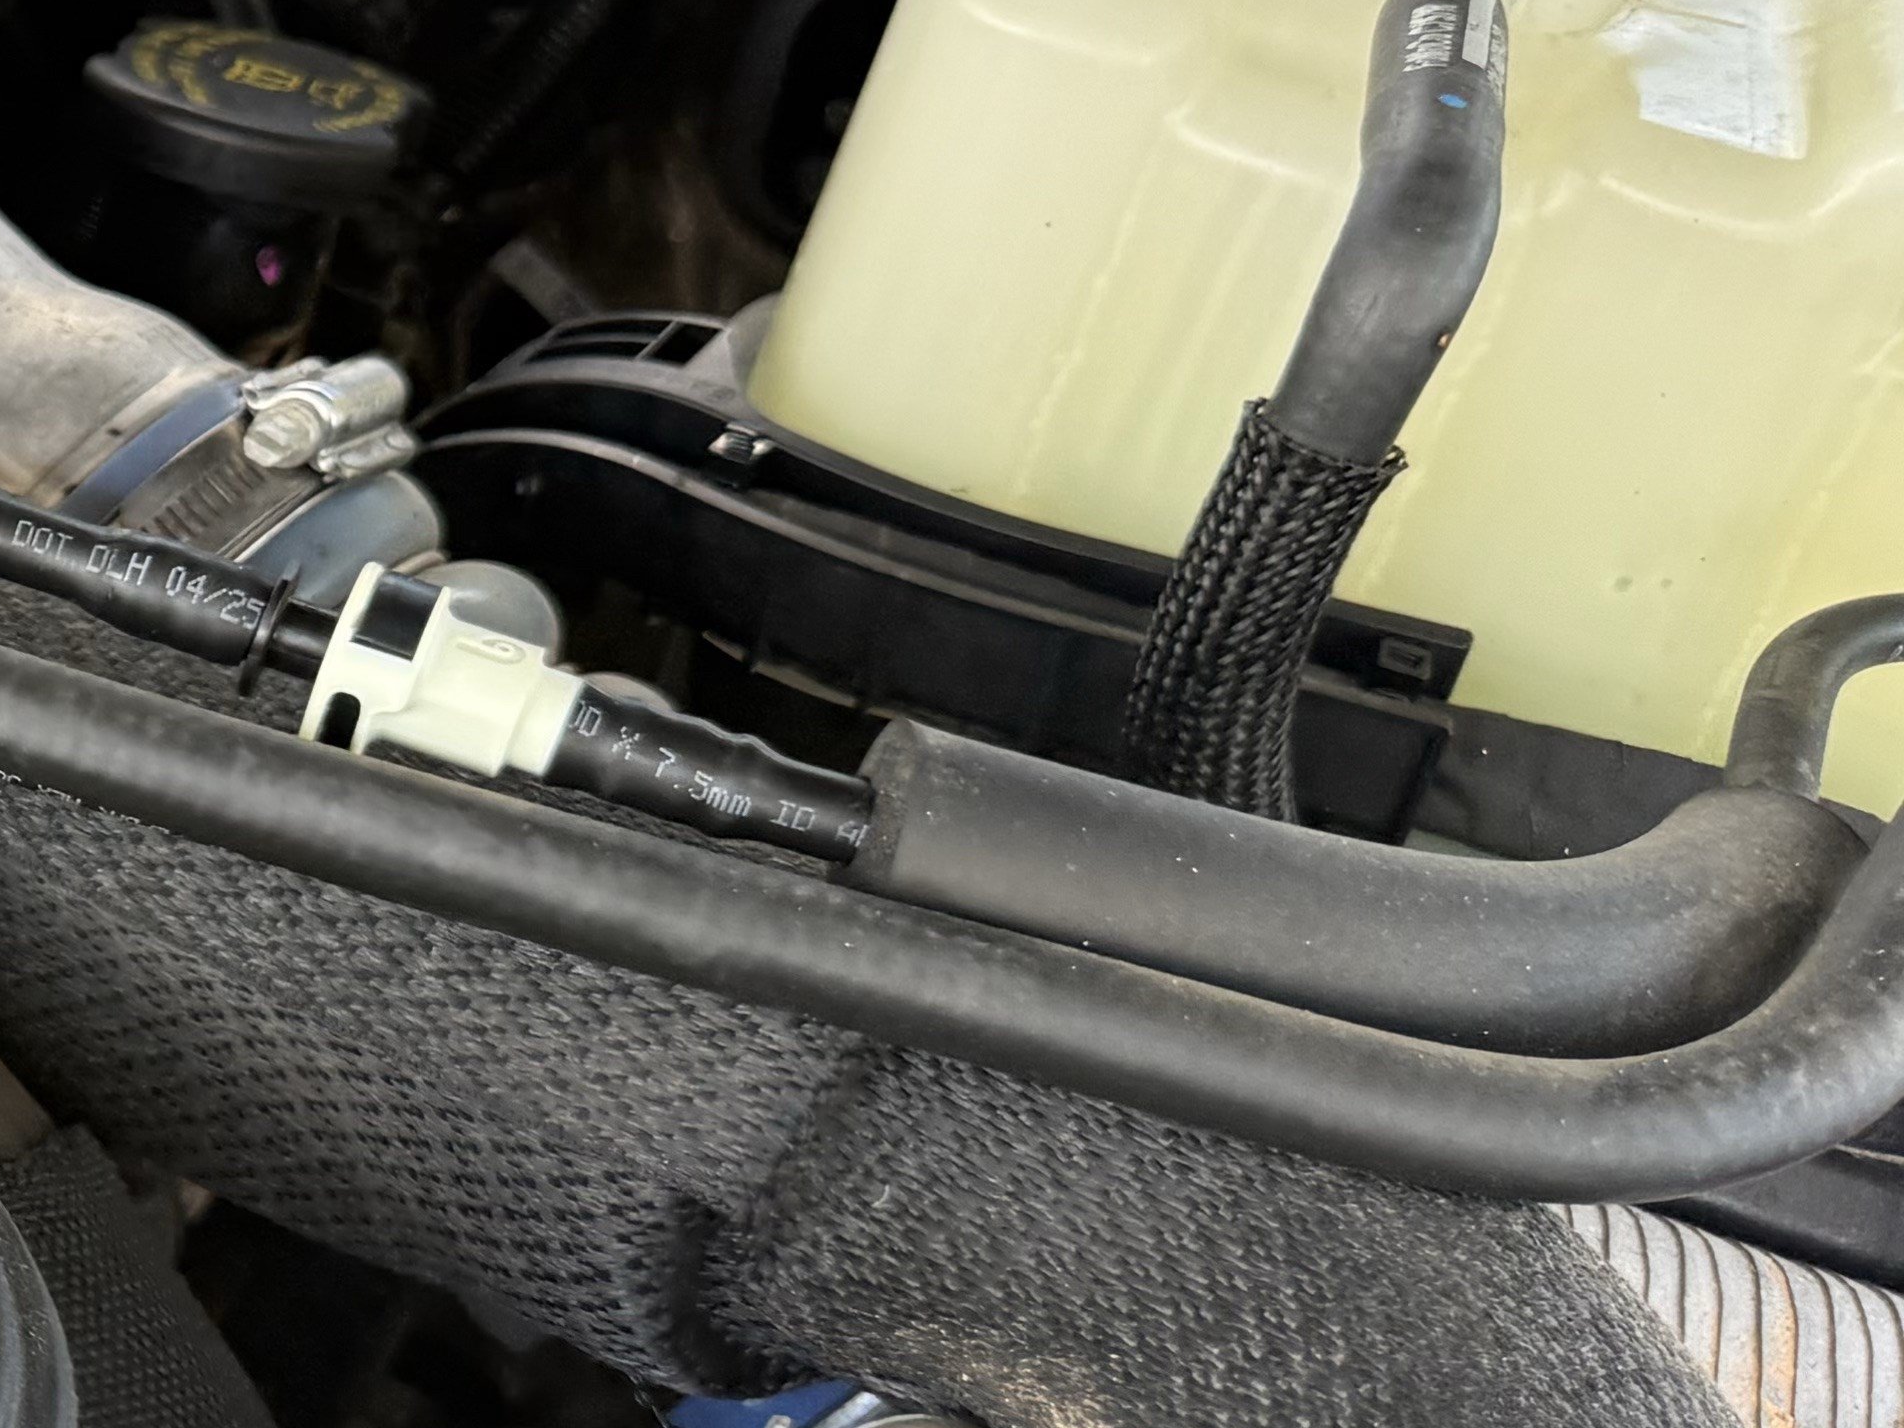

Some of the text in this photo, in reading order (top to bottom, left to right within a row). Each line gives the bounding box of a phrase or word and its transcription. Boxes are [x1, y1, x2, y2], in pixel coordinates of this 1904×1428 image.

[11, 519, 74, 561] DOT
[165, 565, 266, 630] 04/25
[611, 725, 642, 761] X
[654, 745, 754, 819] 7.5mm
[769, 798, 816, 833] ID
